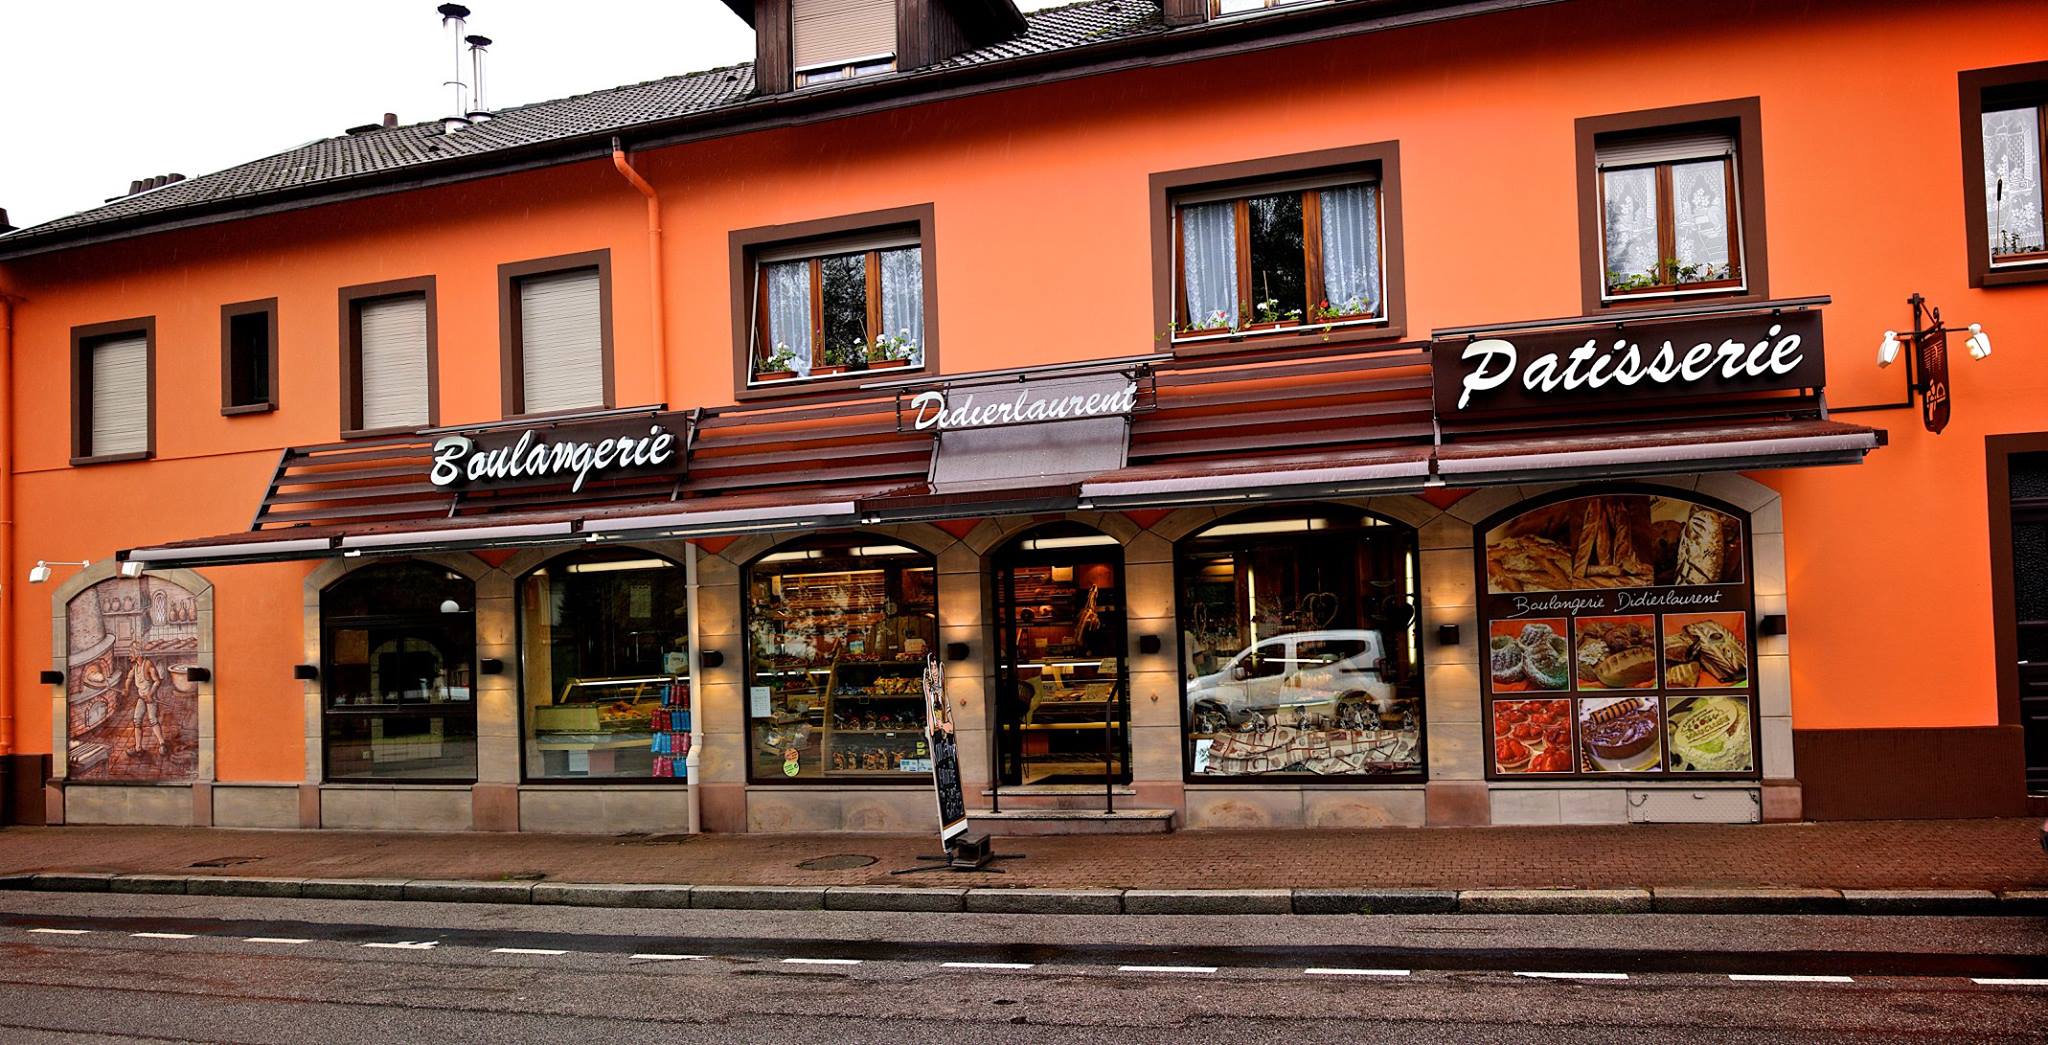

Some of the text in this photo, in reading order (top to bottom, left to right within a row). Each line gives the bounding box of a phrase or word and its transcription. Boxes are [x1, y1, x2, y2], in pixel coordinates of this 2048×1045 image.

[1457, 324, 1803, 409] Patisserie
[911, 382, 1138, 430] Didierlaurent
[430, 424, 675, 494] Boulangerie
[1506, 590, 1723, 618] Boulangerie Didierlaurent
